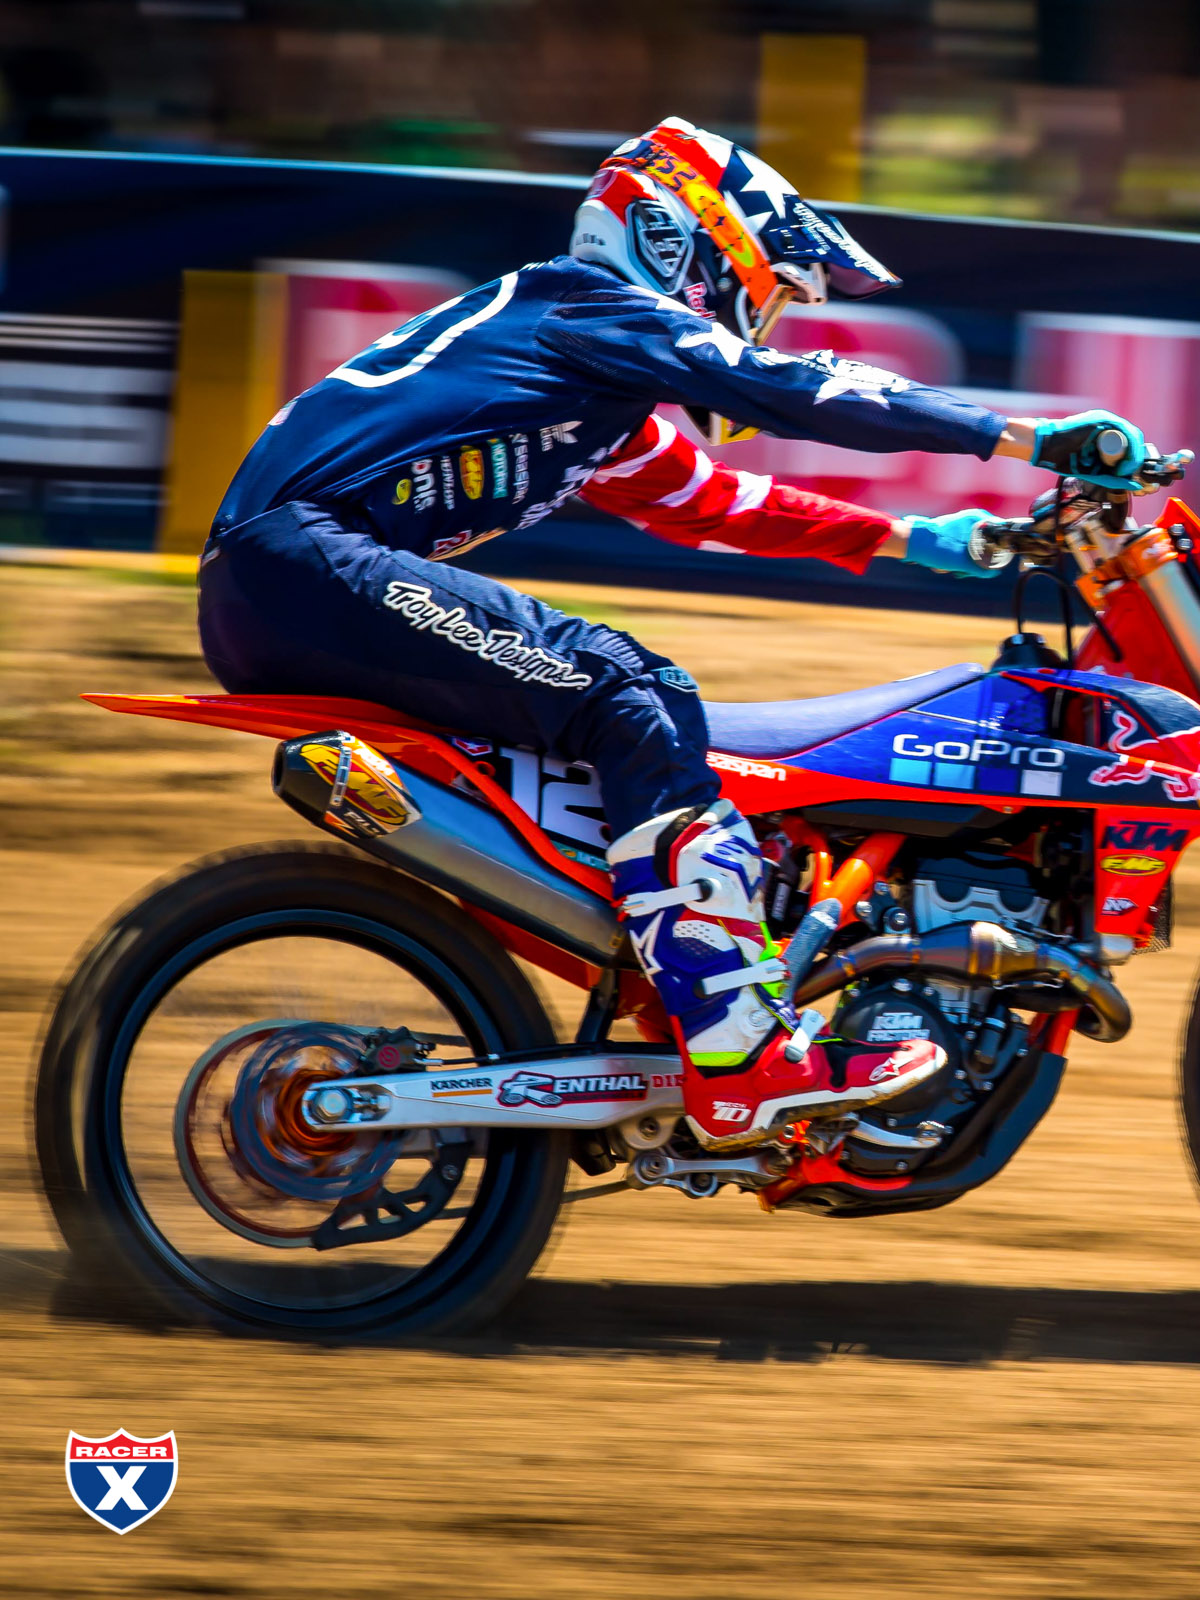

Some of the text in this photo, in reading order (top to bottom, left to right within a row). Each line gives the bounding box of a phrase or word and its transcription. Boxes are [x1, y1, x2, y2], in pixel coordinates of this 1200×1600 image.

[893, 734, 1065, 767] GoPro
[1101, 821, 1190, 851] KTM
[872, 1012, 923, 1030] KTM
